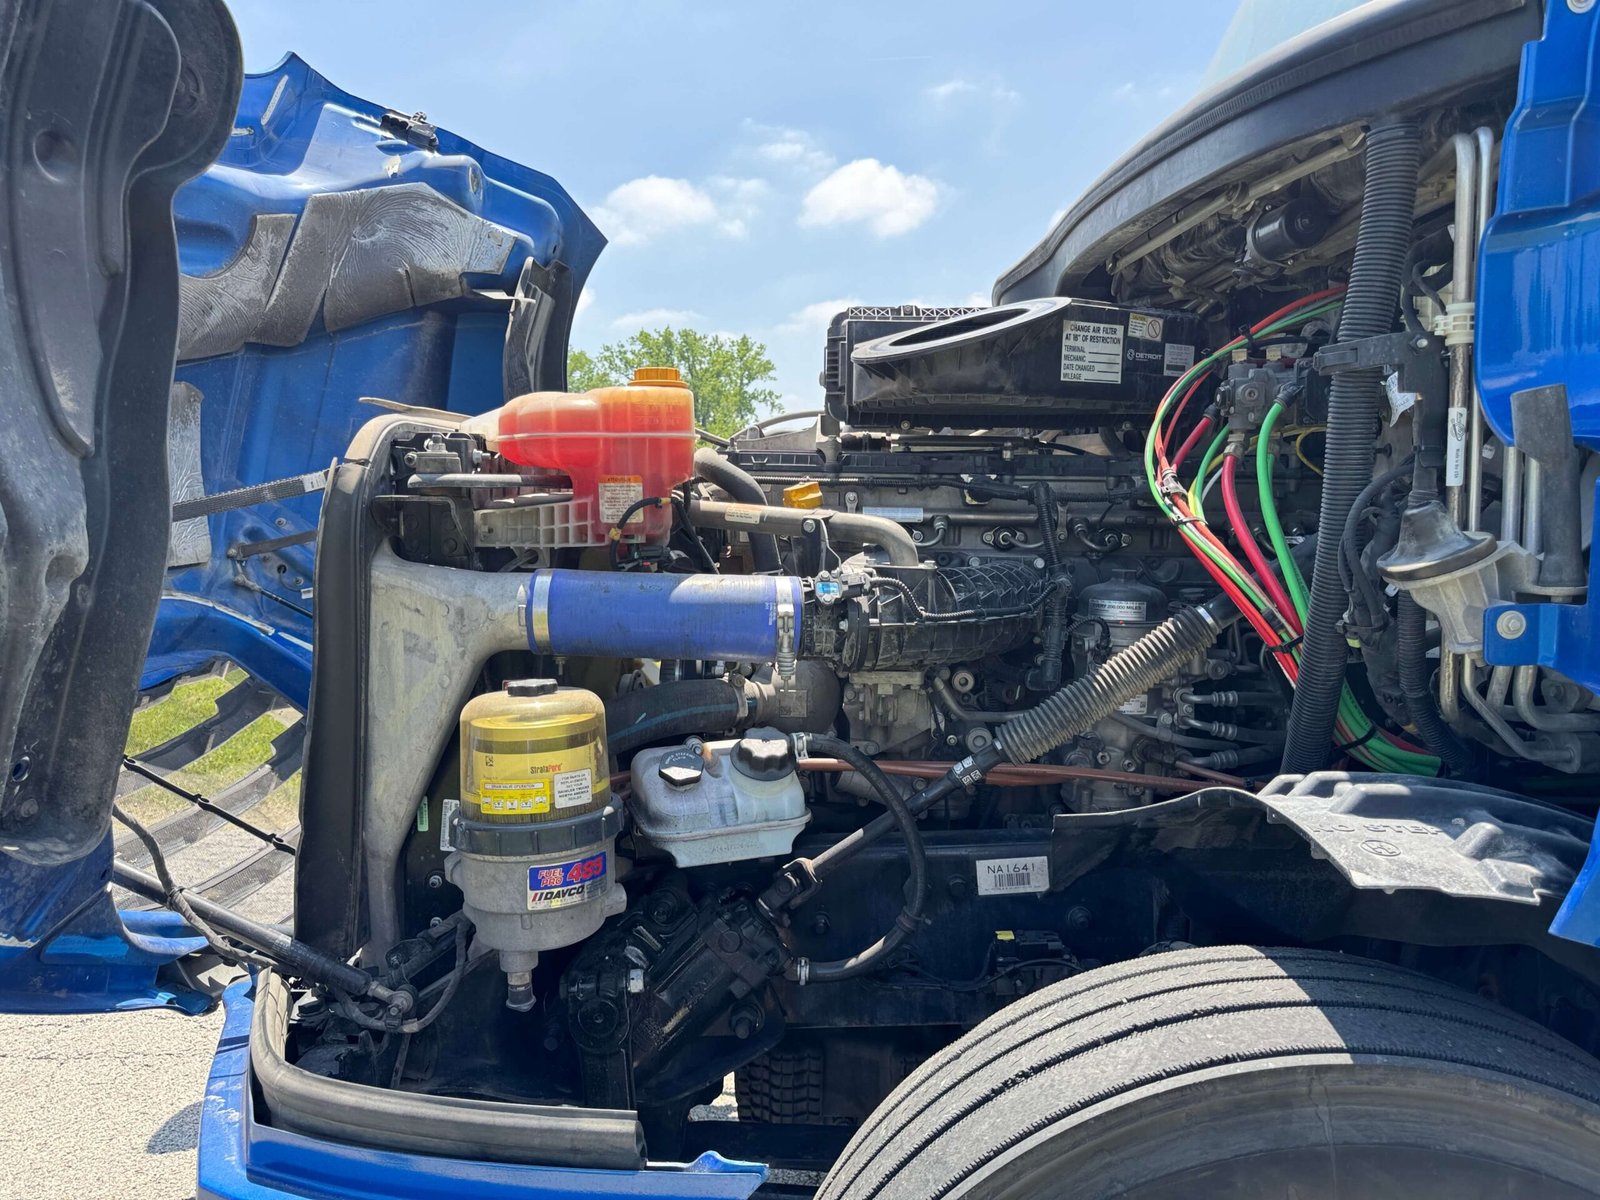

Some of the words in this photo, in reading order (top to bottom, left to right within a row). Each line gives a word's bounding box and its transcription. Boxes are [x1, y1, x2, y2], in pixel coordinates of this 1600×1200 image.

[1070, 324, 1091, 333] CHANGE
[1092, 326, 1101, 334] AIR
[1102, 327, 1118, 335] FILTER
[1065, 333, 1071, 341] AT
[1090, 335, 1121, 344] RESTRICTION
[1064, 345, 1086, 353] TERMINAL
[1064, 354, 1086, 362] MECHANIC
[1136, 352, 1163, 360] DETROIT
[1063, 363, 1074, 371] DATE
[1075, 364, 1095, 372] CHANGED
[530, 763, 561, 775] StrataPore
[1305, 824, 1355, 833] NO
[1363, 824, 1443, 835] STEP
[538, 868, 564, 879] FUEL
[987, 863, 1034, 874] NA1641
[541, 876, 563, 887] PRO
[543, 885, 585, 901] DAVCO
